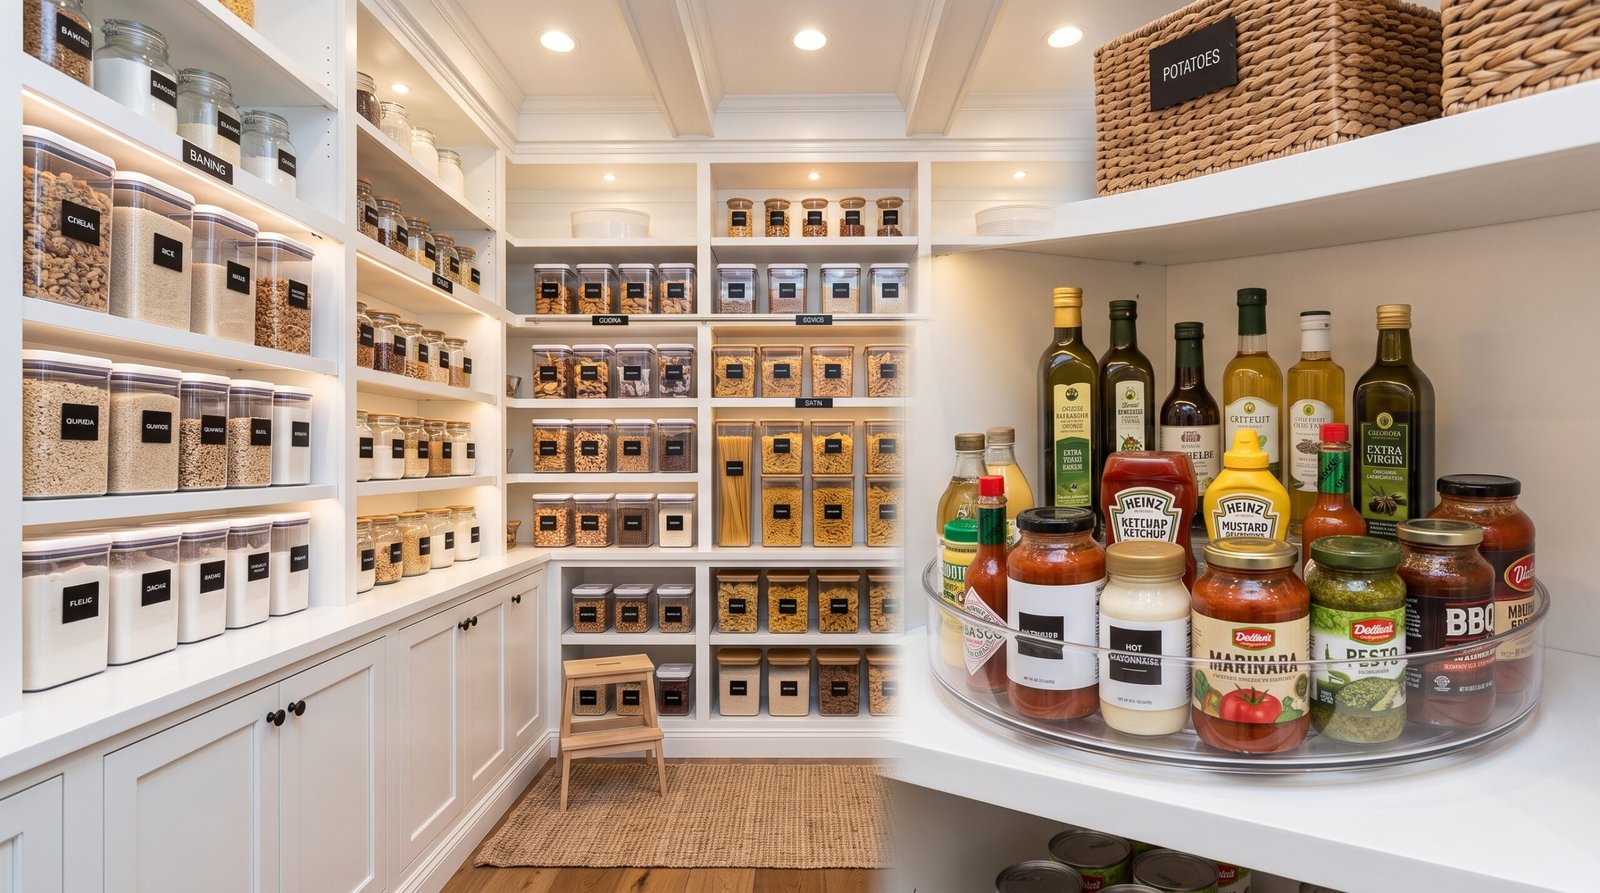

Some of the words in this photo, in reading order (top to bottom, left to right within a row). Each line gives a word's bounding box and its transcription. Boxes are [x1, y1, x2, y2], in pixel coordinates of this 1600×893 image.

[1163, 48, 1221, 82] POTATOES
[190, 149, 226, 176] BANING
[1367, 445, 1402, 456] EXTRA
[1366, 454, 1403, 465] VIRGIN
[1124, 496, 1164, 511] HEINZ
[1226, 501, 1265, 516] HEINZ
[1123, 528, 1167, 539] KETCHUP
[1222, 521, 1268, 532] MUSTARD
[1446, 602, 1496, 637] BBQ
[1125, 643, 1142, 651] HOT
[1109, 653, 1161, 667] MAYONNAISE
[1209, 649, 1298, 675] MARINARA
[1346, 646, 1399, 668] PESTO
